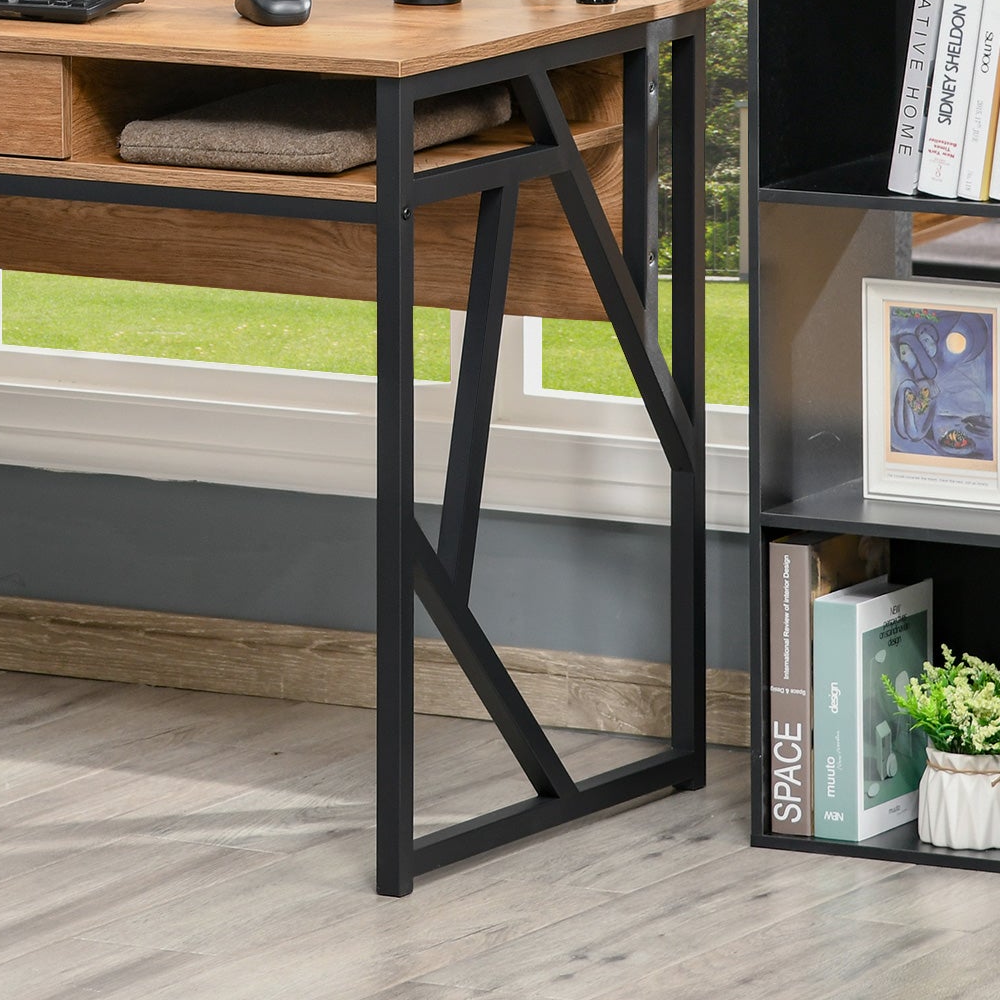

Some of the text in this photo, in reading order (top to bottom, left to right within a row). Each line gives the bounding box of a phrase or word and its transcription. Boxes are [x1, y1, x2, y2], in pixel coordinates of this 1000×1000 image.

[938, 3, 967, 125] SIDNEY SHELDON
[898, 86, 920, 156] HOME
[783, 555, 791, 578] Design
[783, 604, 790, 612] of
[828, 682, 841, 714] design
[773, 721, 802, 823] SPACE
[826, 756, 836, 797] muuto
